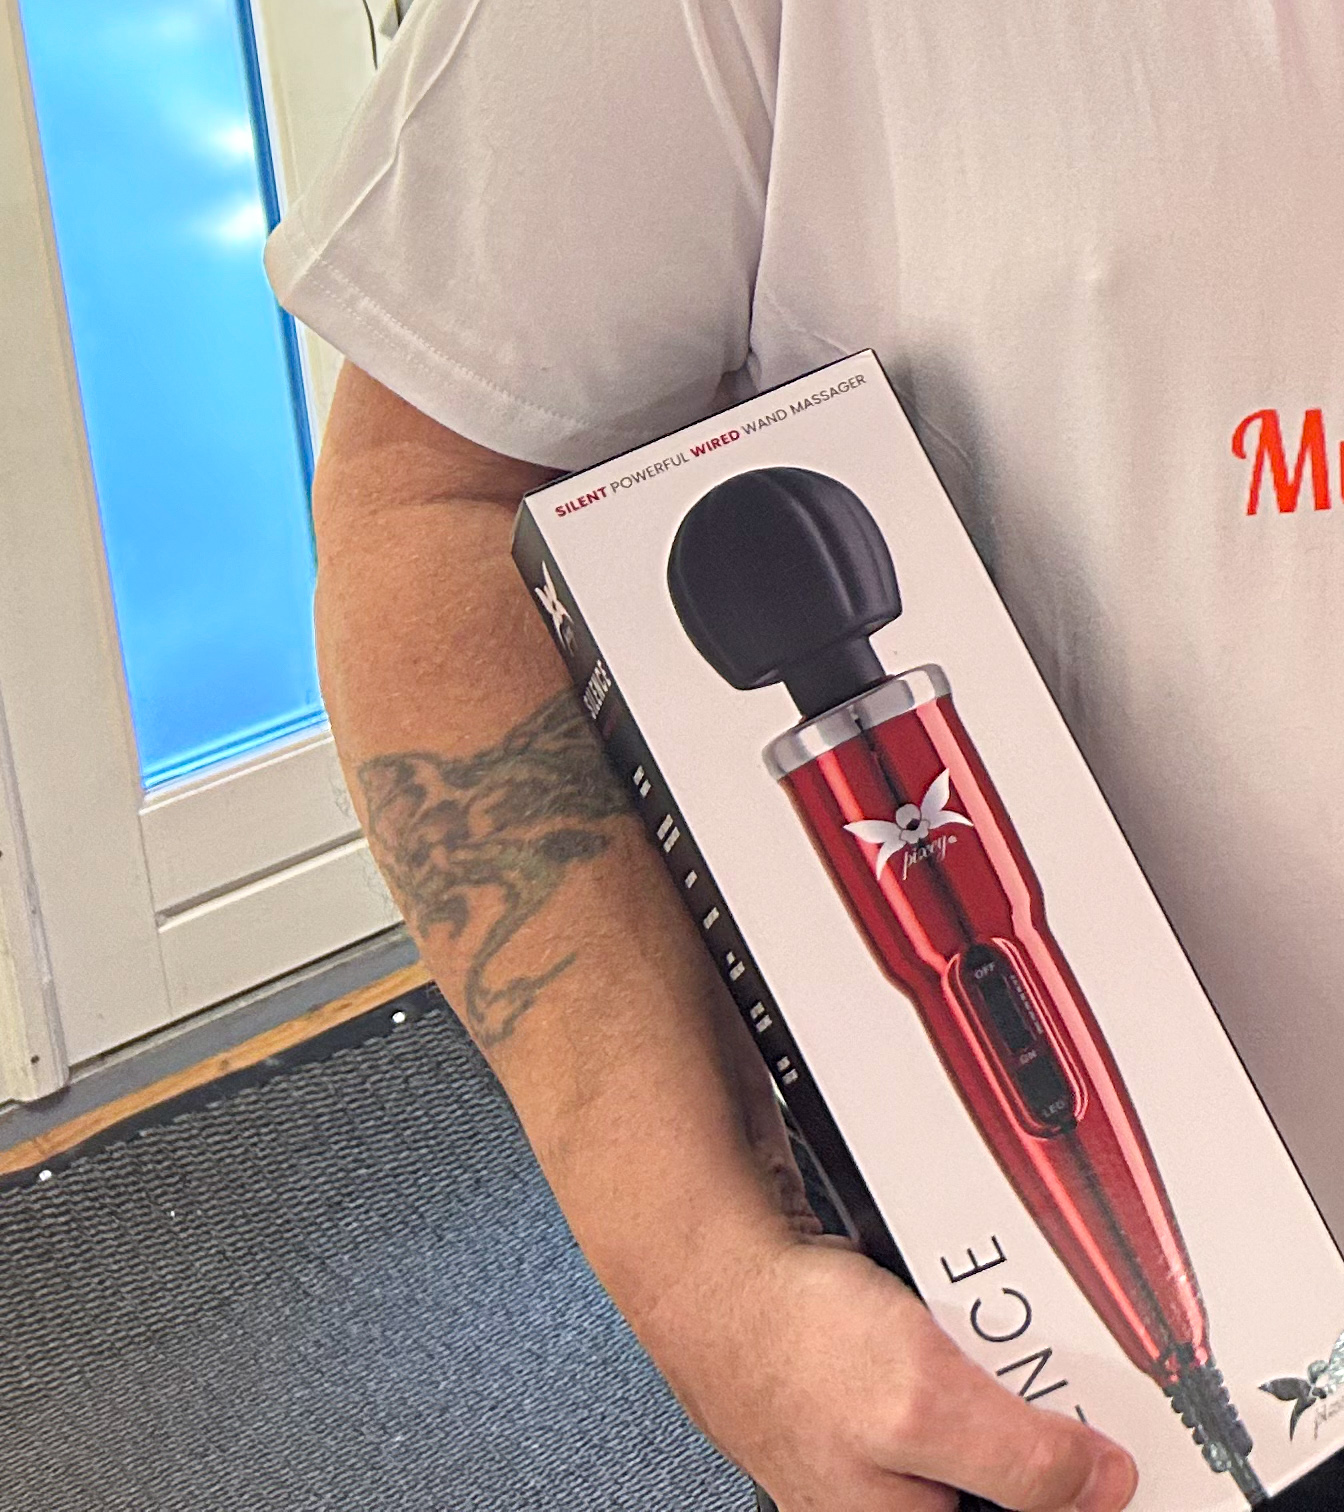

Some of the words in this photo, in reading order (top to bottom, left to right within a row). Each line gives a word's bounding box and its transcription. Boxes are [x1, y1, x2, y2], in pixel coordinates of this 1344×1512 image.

[554, 484, 608, 519] SILENT
[609, 451, 689, 494] POWERFUL
[689, 428, 741, 459] WIRED
[741, 408, 788, 436] WAND
[789, 373, 867, 416] MASSAGER
[974, 961, 996, 980] OFF
[940, 1234, 1088, 1425] NCE
